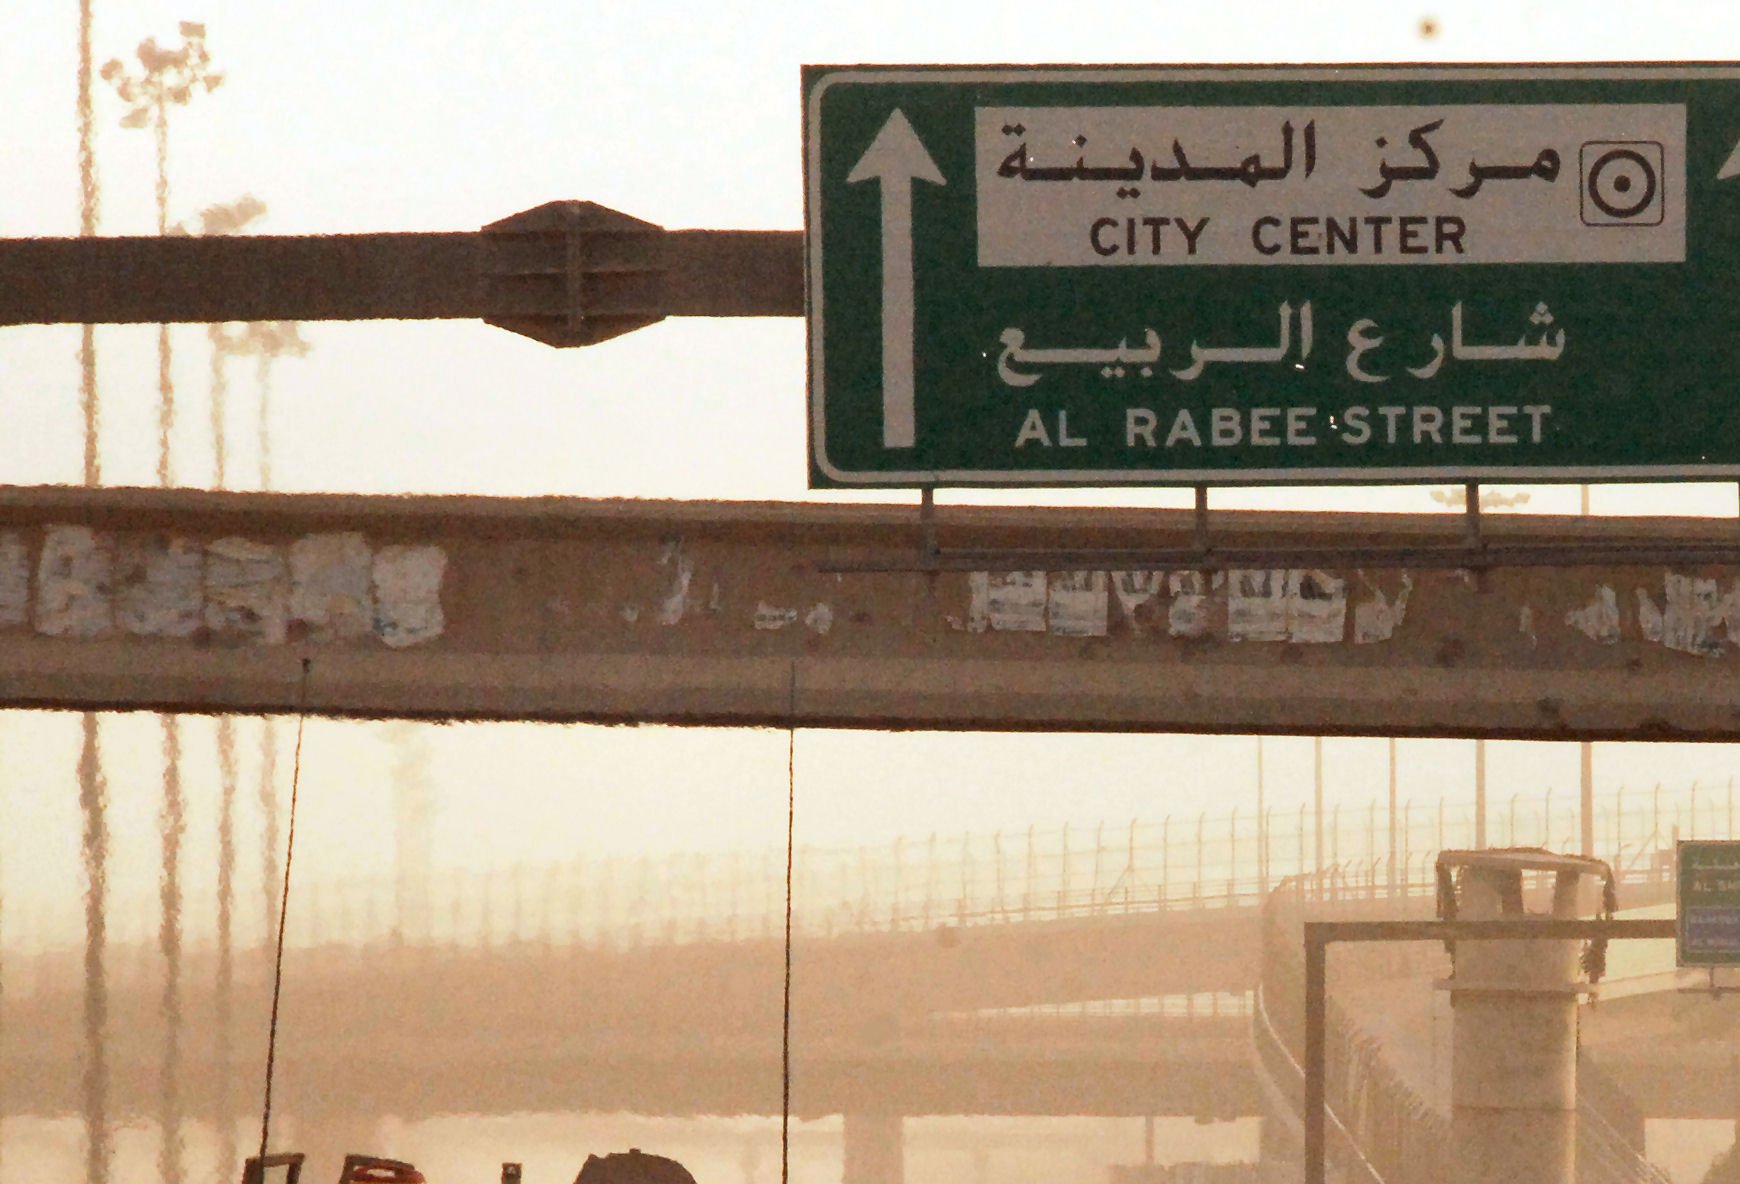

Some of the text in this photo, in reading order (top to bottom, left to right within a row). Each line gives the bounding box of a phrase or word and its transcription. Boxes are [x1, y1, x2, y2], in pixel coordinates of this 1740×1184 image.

[997, 118, 1561, 200] مركز المدينة
[1089, 215, 1467, 257] CITY CENTER
[997, 300, 1566, 387] شارع الربيع
[1014, 404, 1552, 448] AL RABEE STREET
